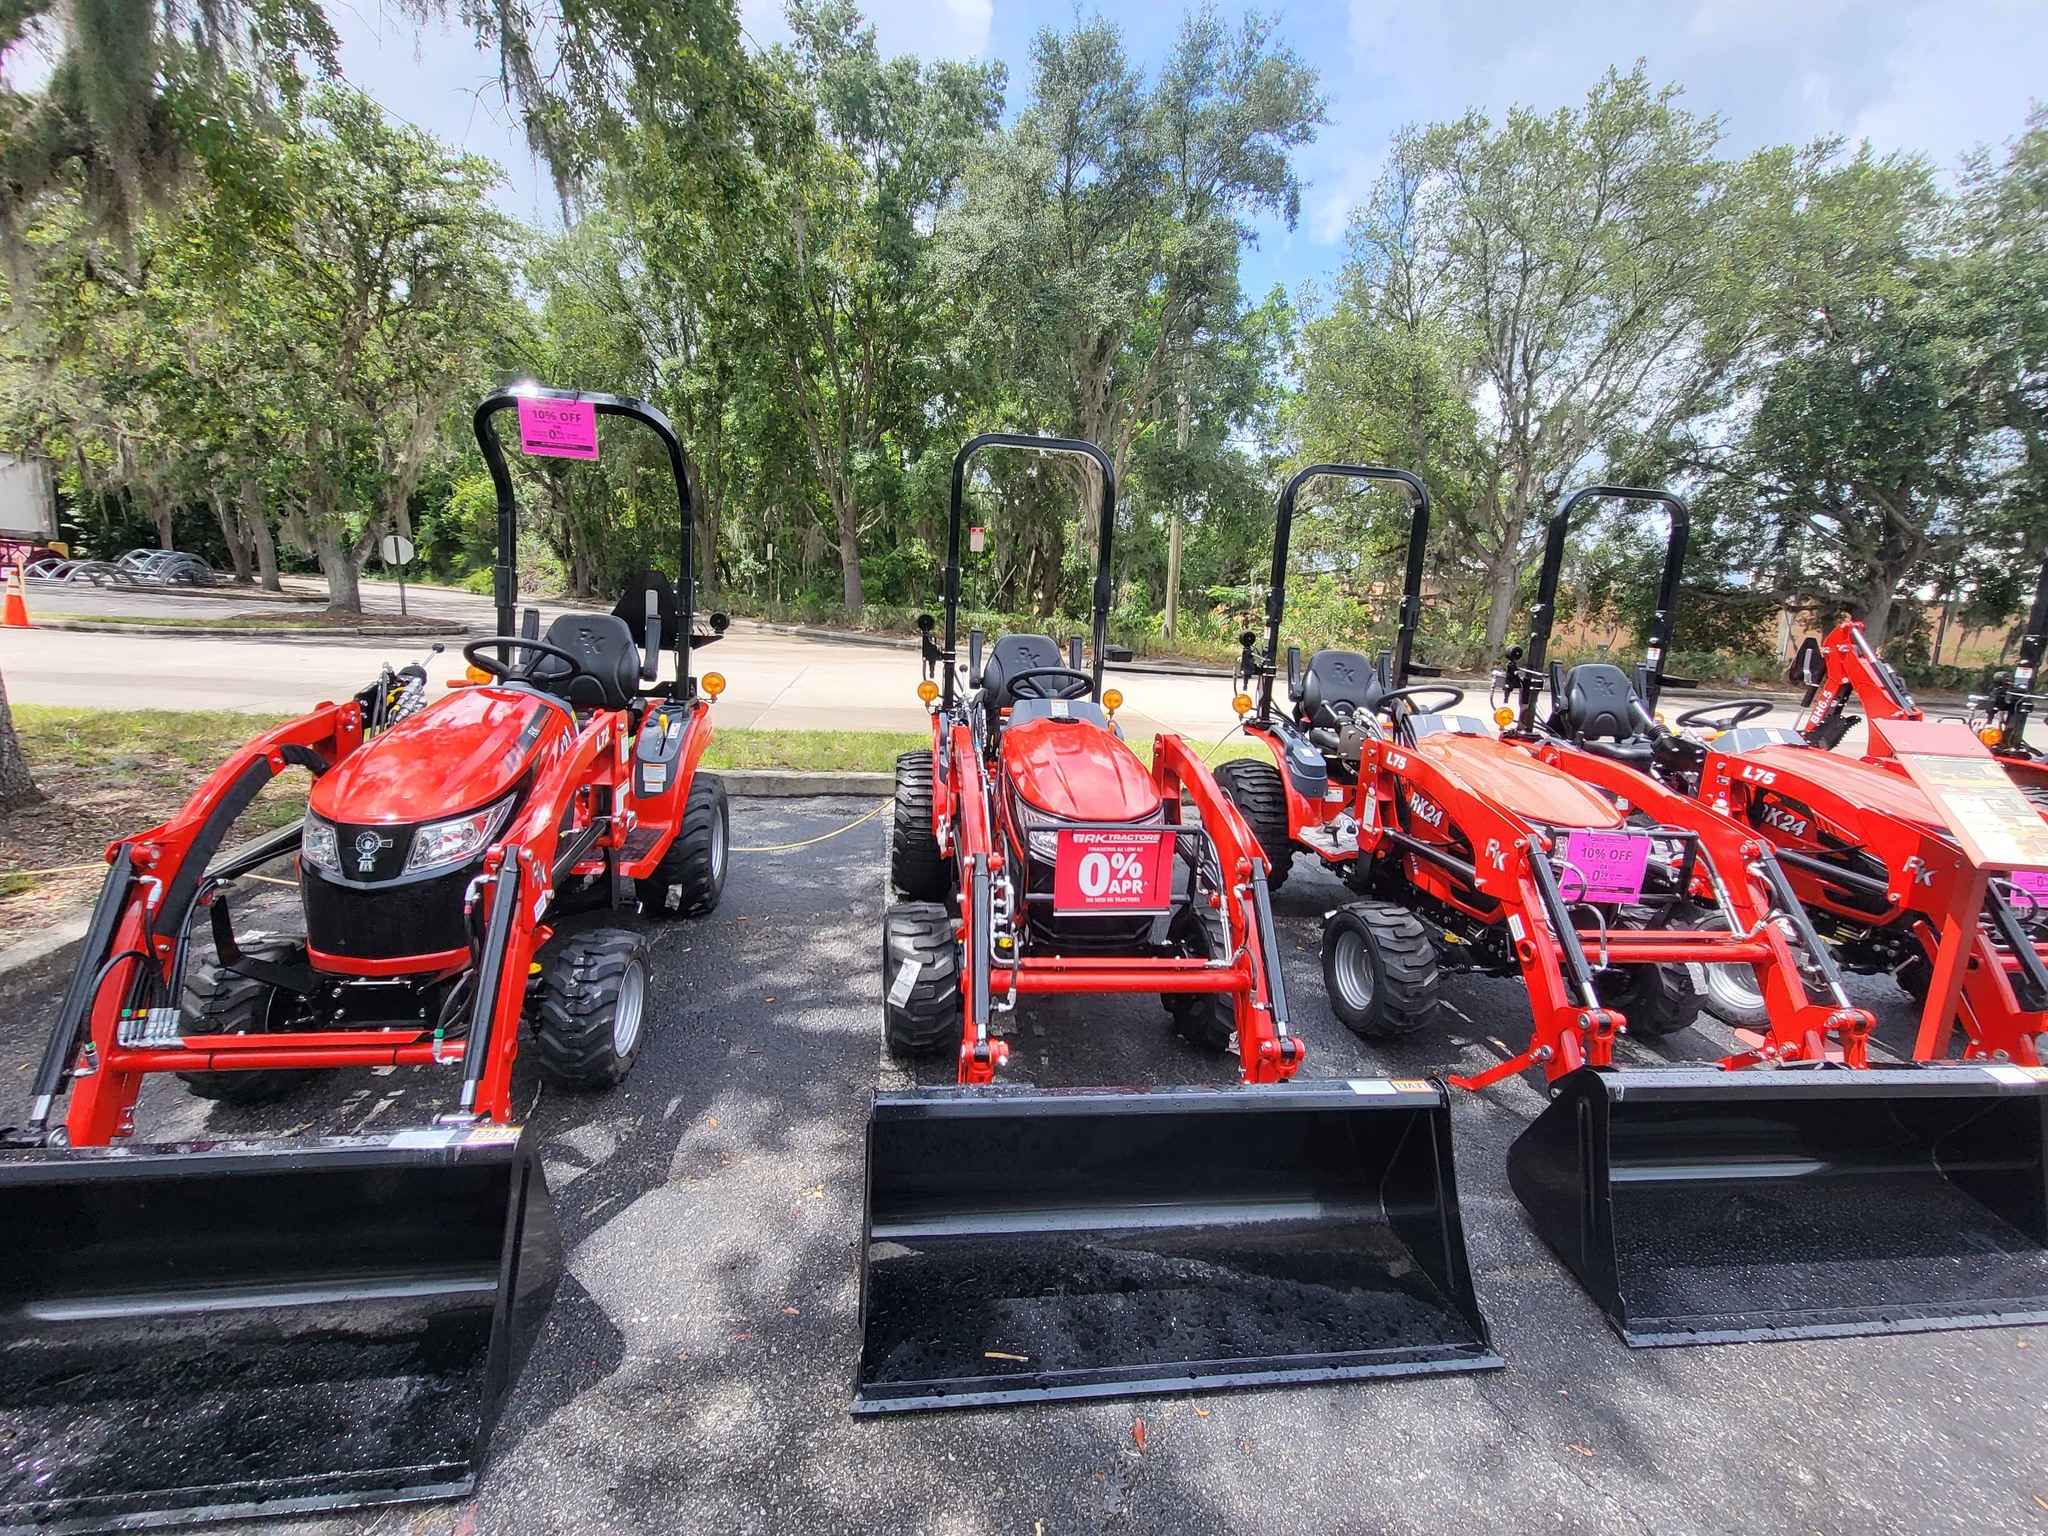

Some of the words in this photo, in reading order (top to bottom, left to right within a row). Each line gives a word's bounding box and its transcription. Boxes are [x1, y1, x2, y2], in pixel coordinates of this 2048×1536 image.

[532, 410, 557, 420] 10%
[560, 413, 582, 422] OFF
[1331, 662, 1355, 685] RK
[1594, 675, 1615, 697] RK
[1810, 690, 1833, 724] BH6.5
[1386, 751, 1407, 770] L75
[1741, 765, 1776, 785] L75
[1410, 791, 1443, 828] RK24
[1084, 834, 1108, 844] RK
[1485, 838, 1509, 872] RK
[1581, 847, 1606, 859] 10%
[1609, 849, 1632, 860] OFF
[532, 859, 547, 890] RK
[1078, 852, 1143, 896] 0%
[1902, 855, 1939, 887] RK
